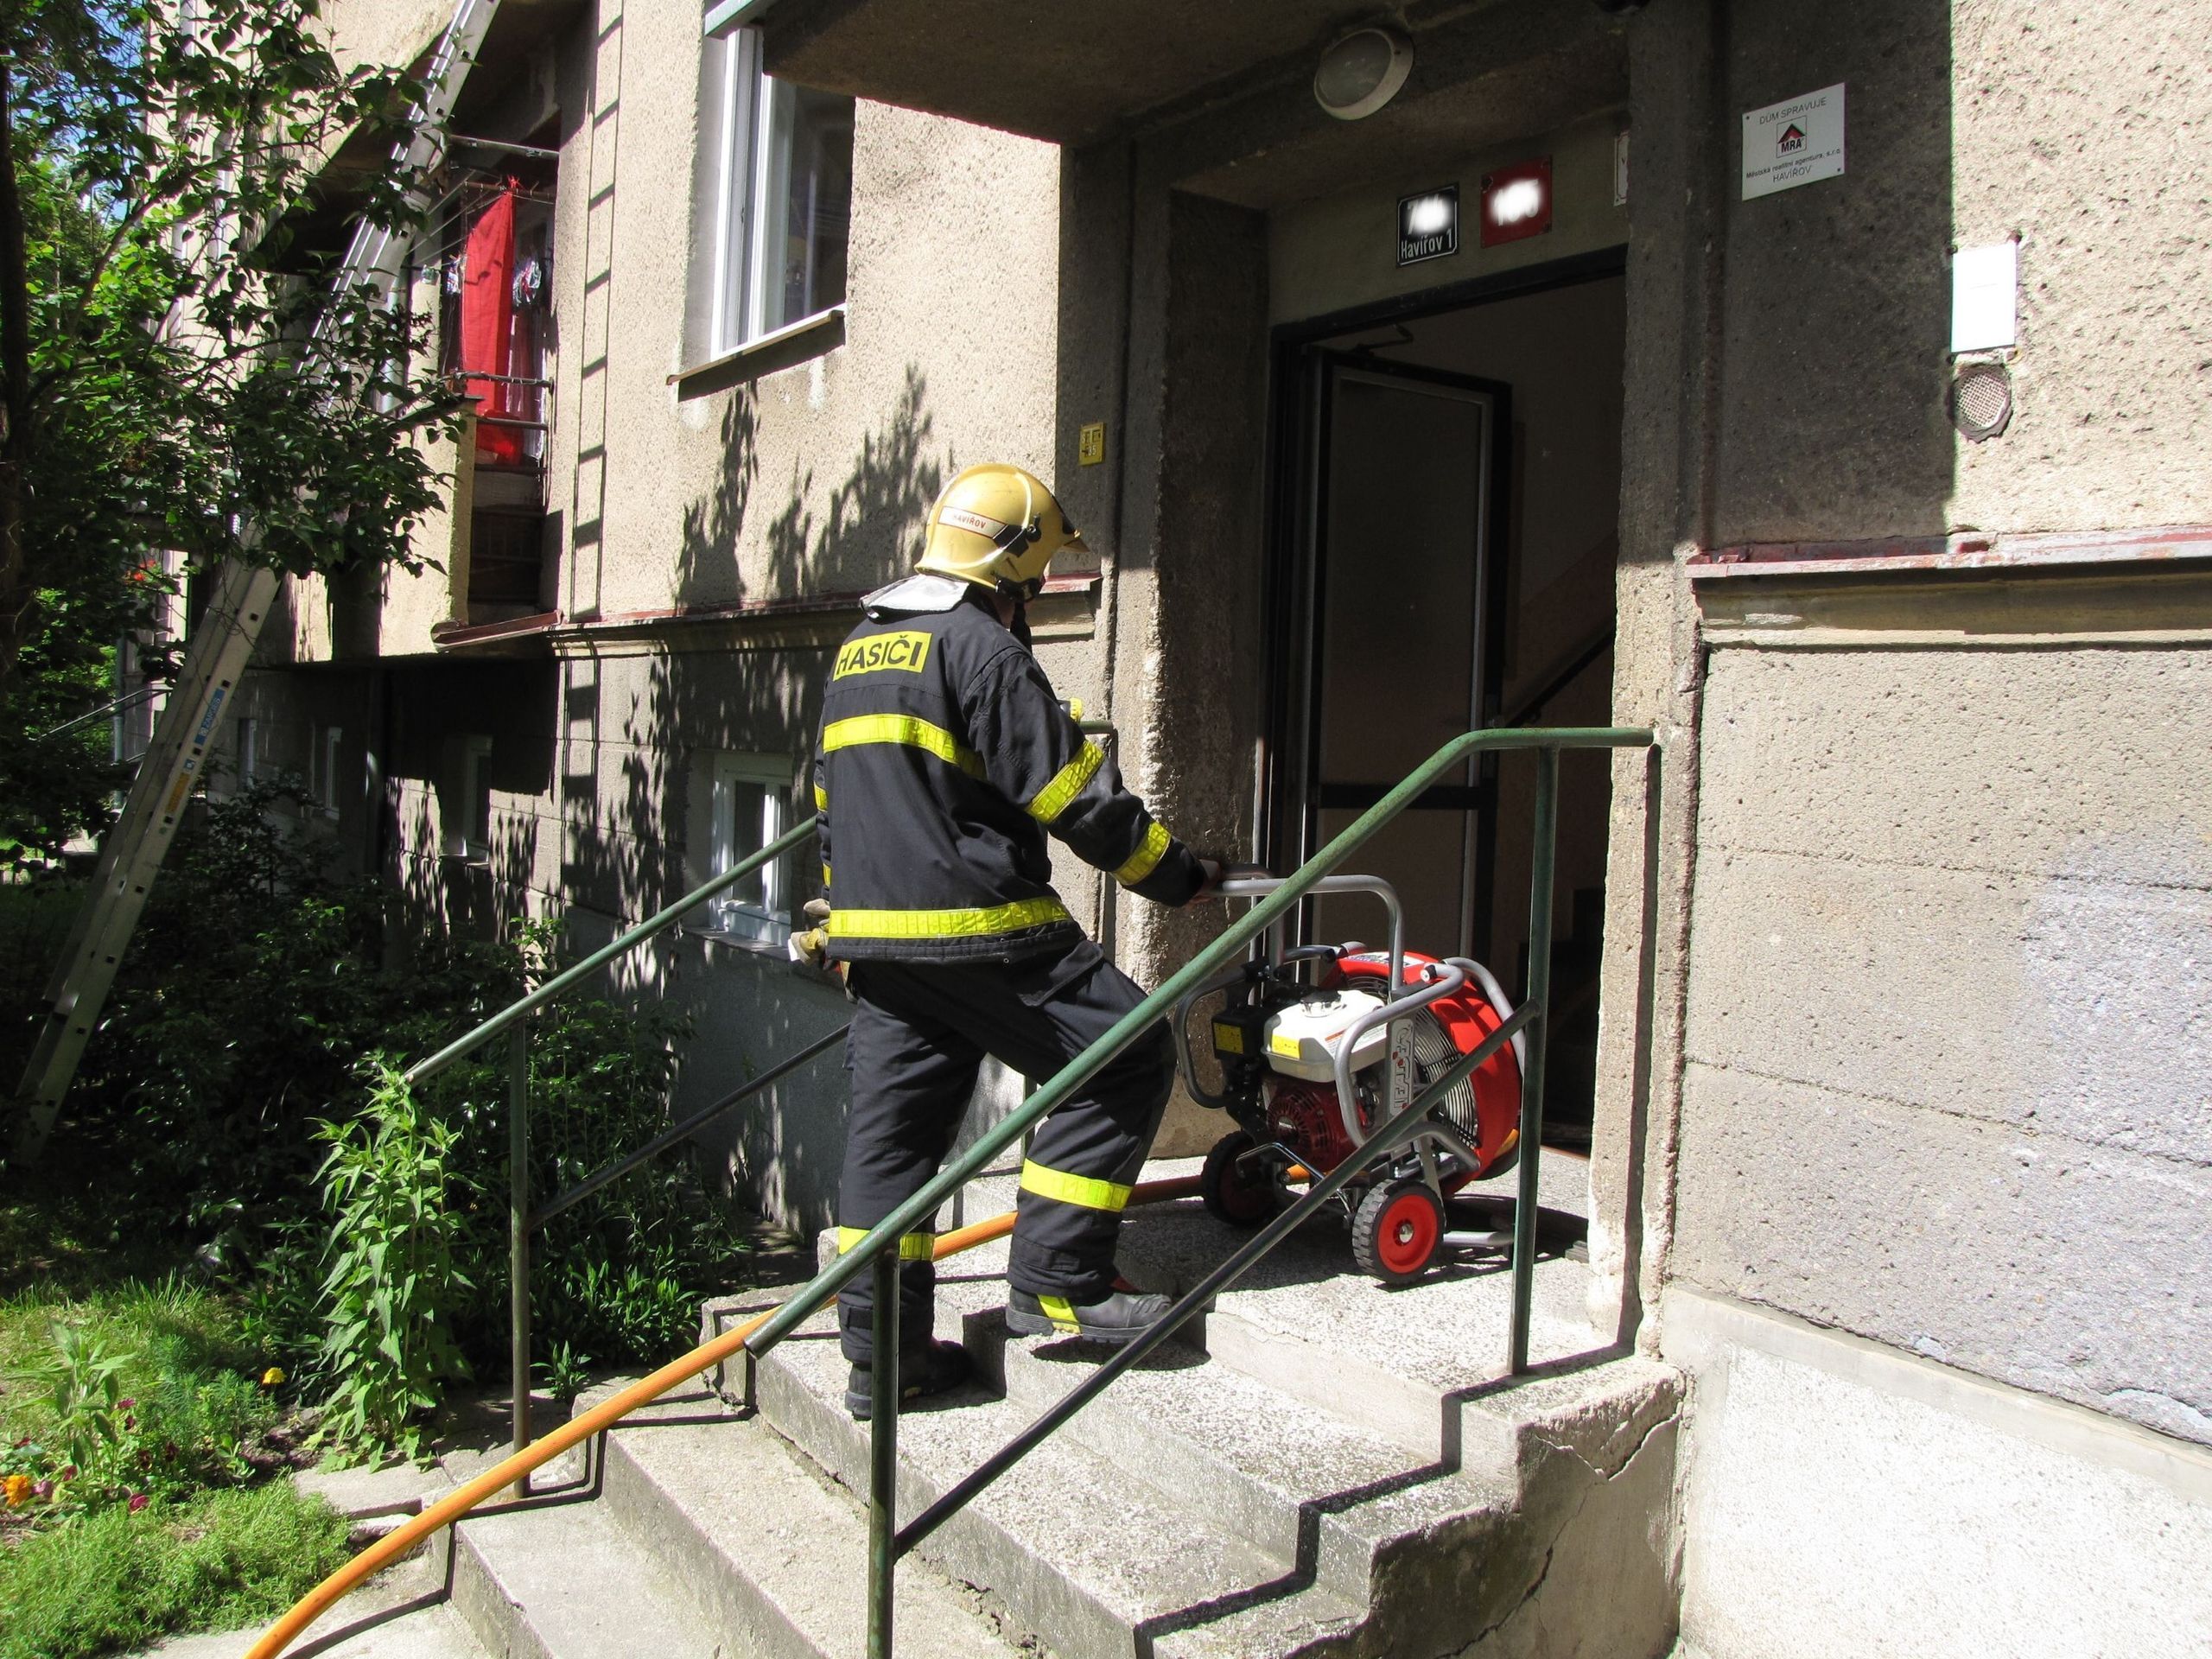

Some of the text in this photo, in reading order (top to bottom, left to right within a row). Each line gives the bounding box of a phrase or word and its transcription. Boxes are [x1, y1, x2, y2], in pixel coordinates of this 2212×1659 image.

[1781, 97, 1827, 118] SPRAVUJE
[1781, 138, 1802, 153] MRA
[1401, 227, 1452, 259] Havířov 1
[836, 635, 924, 675] HASIČI
